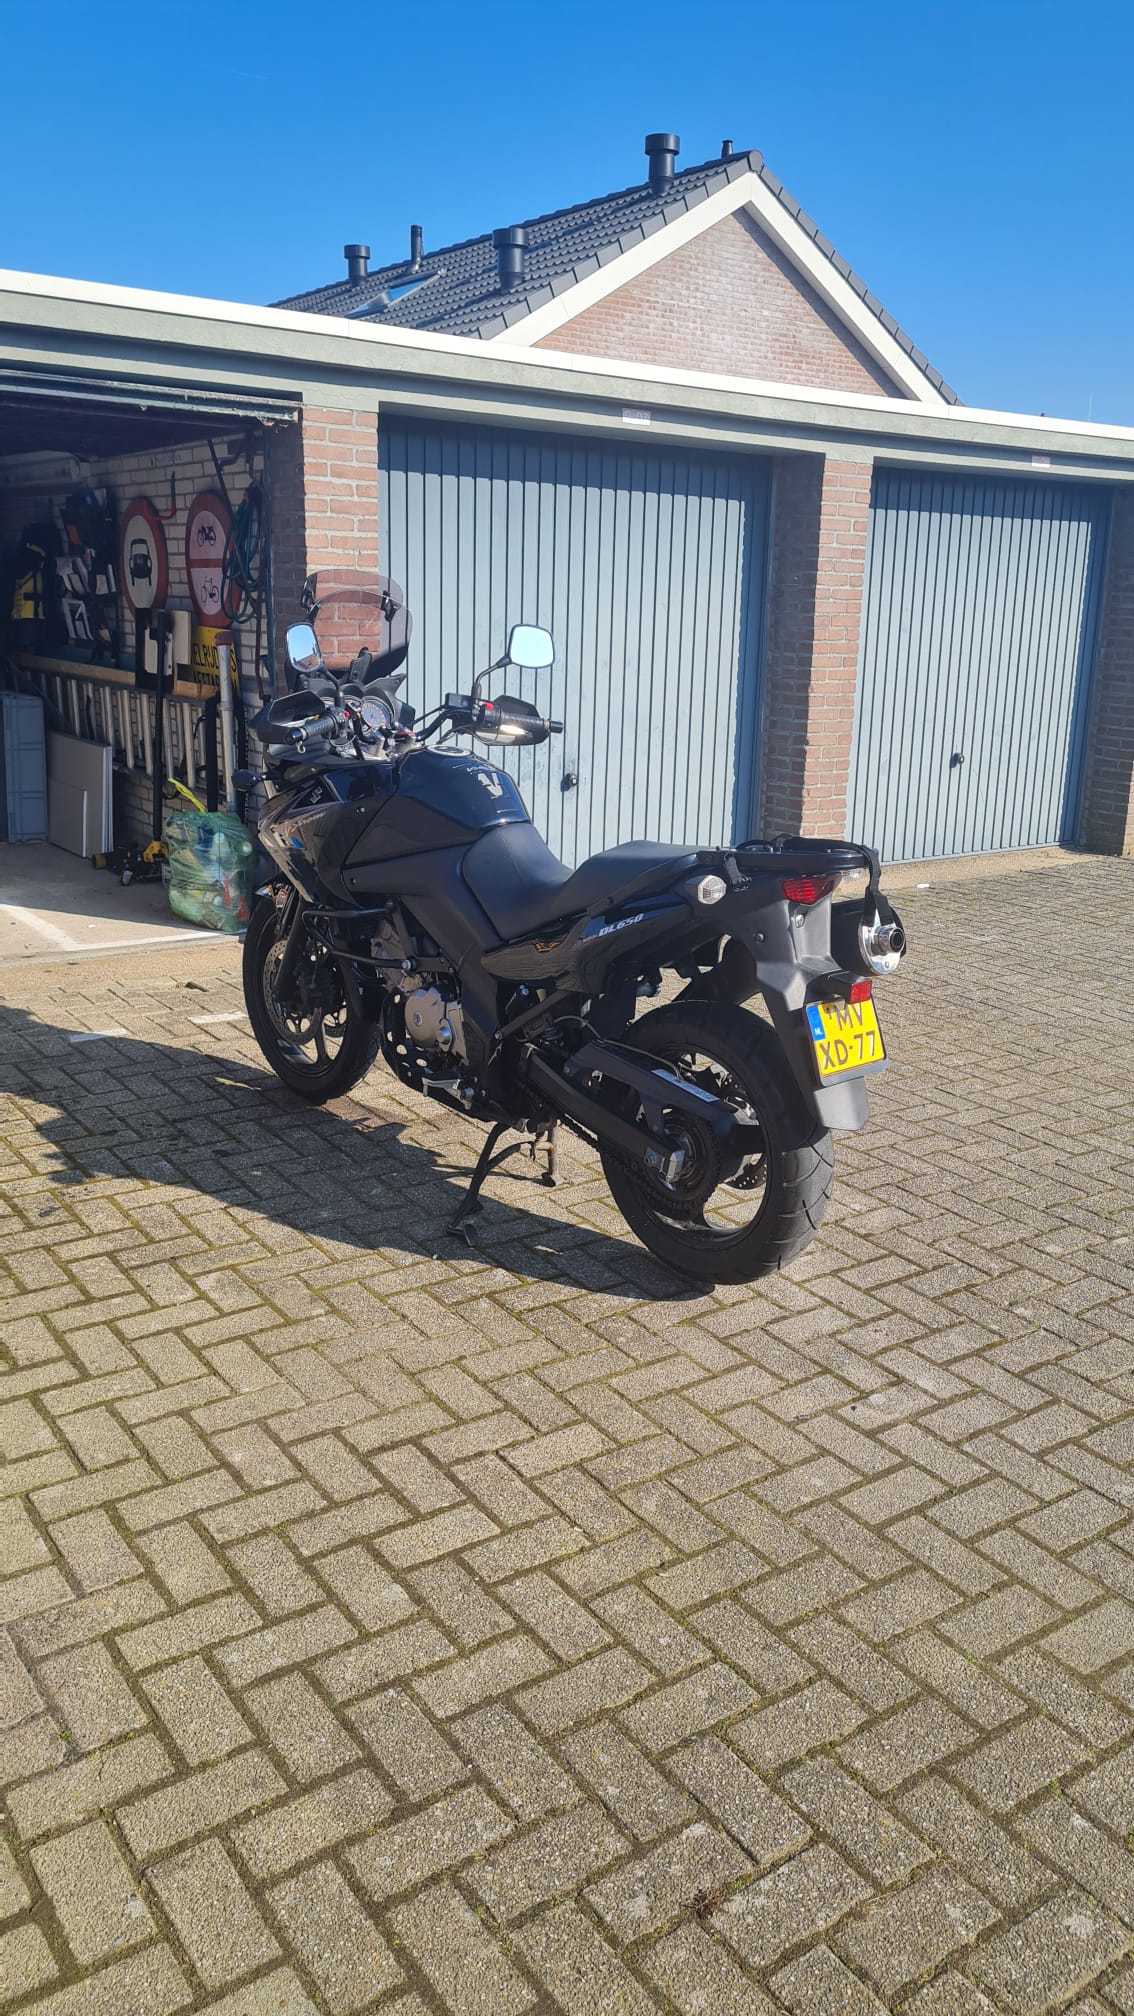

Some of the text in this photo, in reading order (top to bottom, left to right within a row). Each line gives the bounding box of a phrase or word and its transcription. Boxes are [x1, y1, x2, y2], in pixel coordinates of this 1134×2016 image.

[598, 913, 645, 937] DL650
[834, 1001, 863, 1032] MV
[819, 1030, 876, 1070] XD-77
